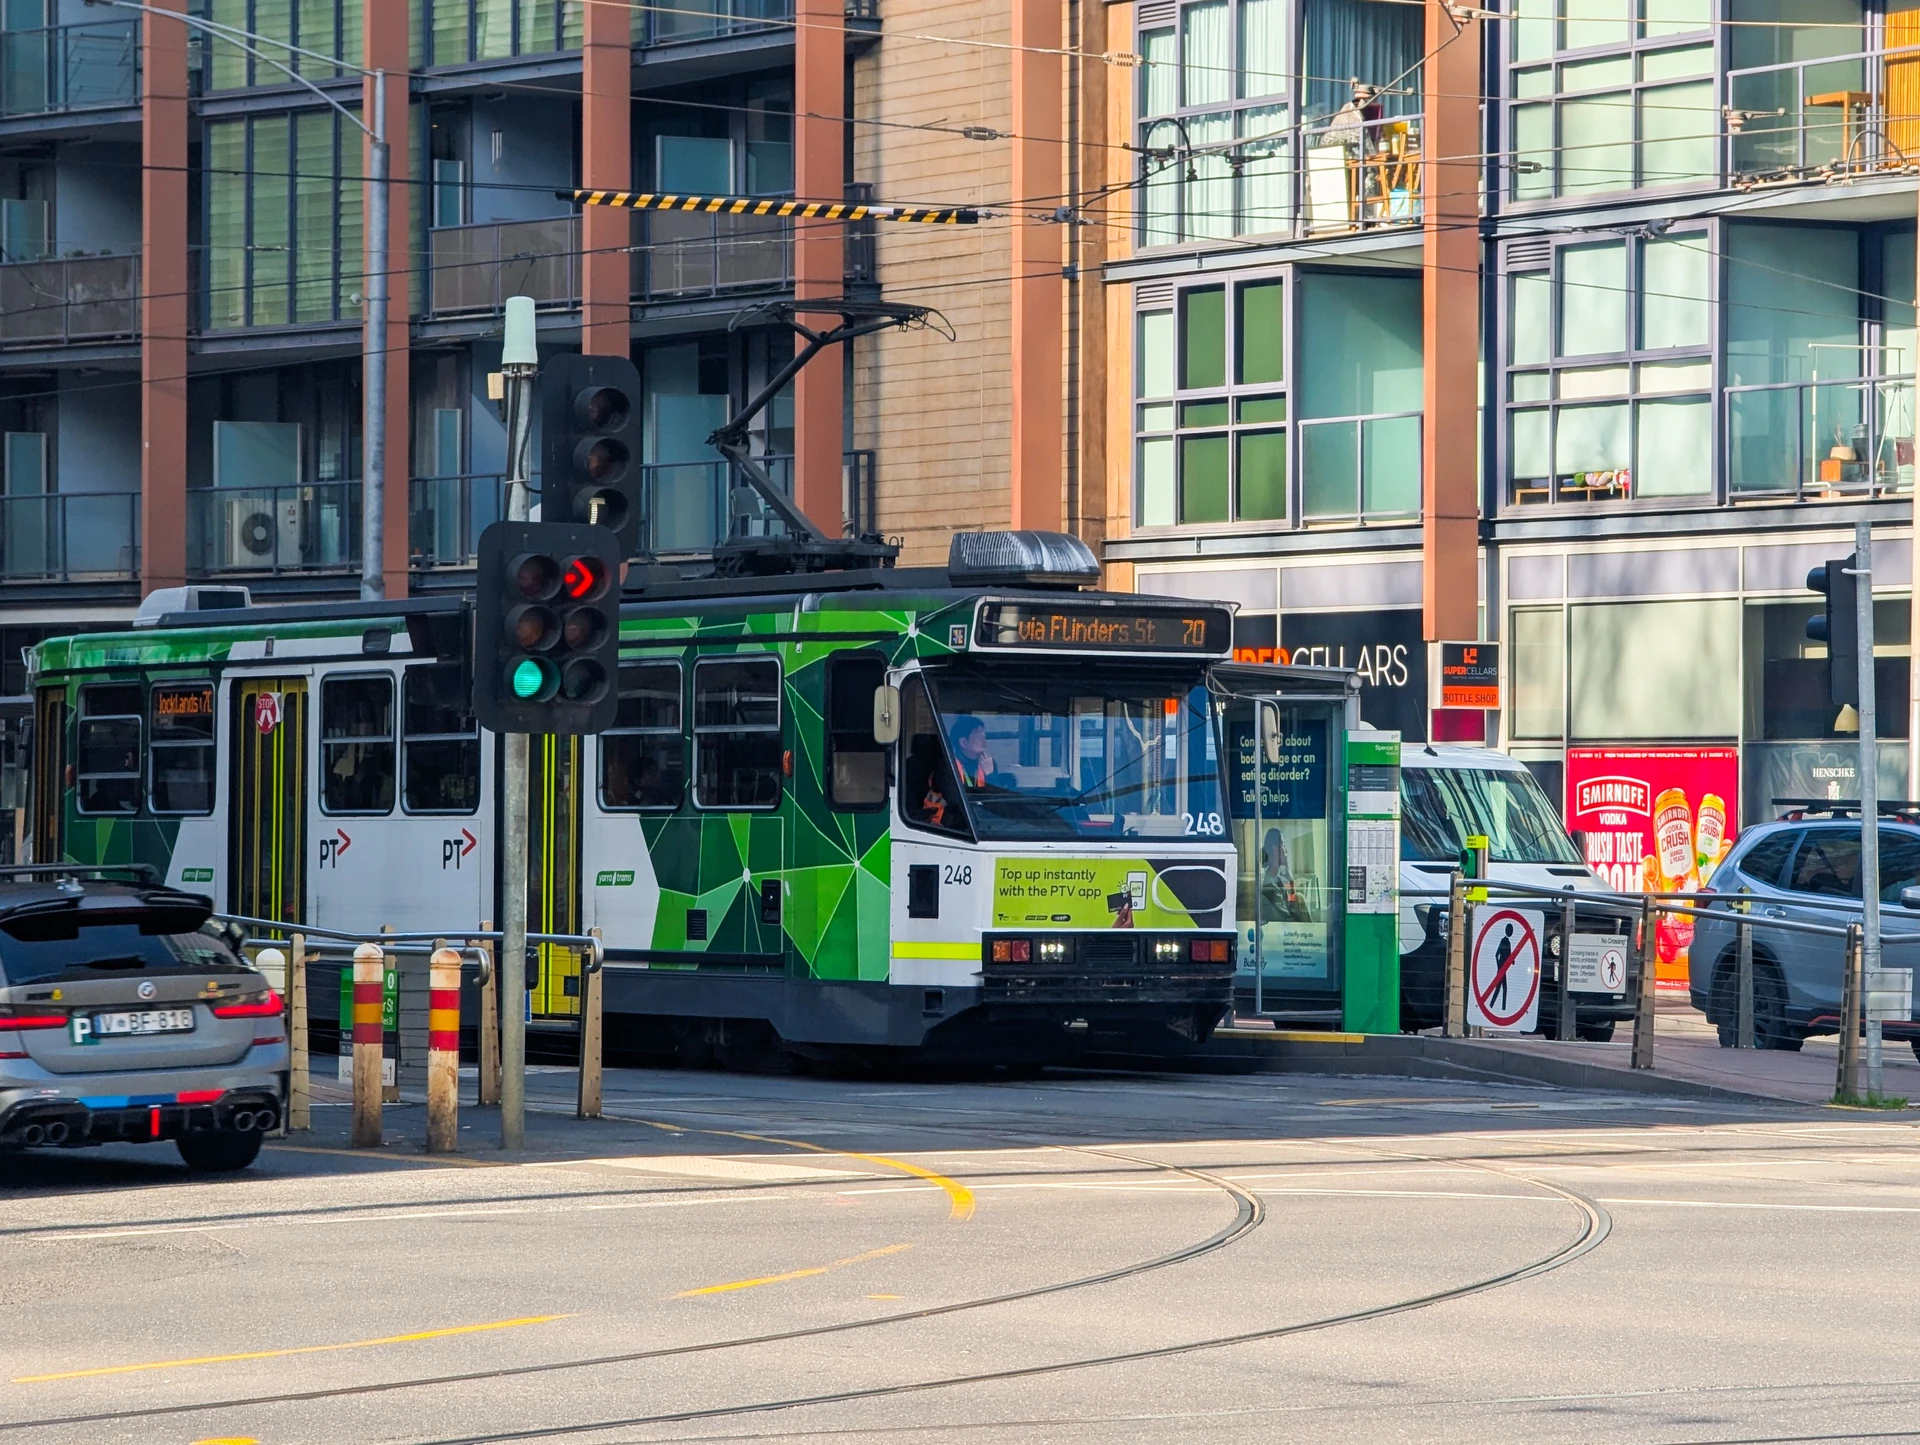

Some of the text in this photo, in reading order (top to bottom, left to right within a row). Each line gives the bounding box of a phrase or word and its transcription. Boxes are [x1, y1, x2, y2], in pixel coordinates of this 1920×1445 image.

[1018, 615, 1206, 645] via Flinders St 70
[1443, 666, 1498, 676] SUPERCELLARS
[258, 698, 274, 709] STOP
[1443, 693, 1496, 703] BOTTLE SHOP
[1285, 733, 1312, 747] about
[1292, 754, 1302, 764] or
[1303, 754, 1316, 764] an
[1241, 767, 1310, 784] eatig disorder?
[1813, 767, 1855, 778] HENSCHKE
[1269, 789, 1290, 807] helps
[1181, 812, 1224, 836] 248
[1599, 813, 1628, 825] VODKA
[1656, 807, 1688, 830] SMIRNOFF
[1665, 823, 1684, 835] VODKA
[1700, 823, 1720, 840] CRUSH
[1615, 832, 1644, 862] TASTE
[1661, 831, 1690, 853] CRUSH
[944, 865, 972, 885] 248
[1000, 868, 1096, 883] Top up instantly
[999, 885, 1102, 899] with the PTV app
[73, 1018, 91, 1043] P
